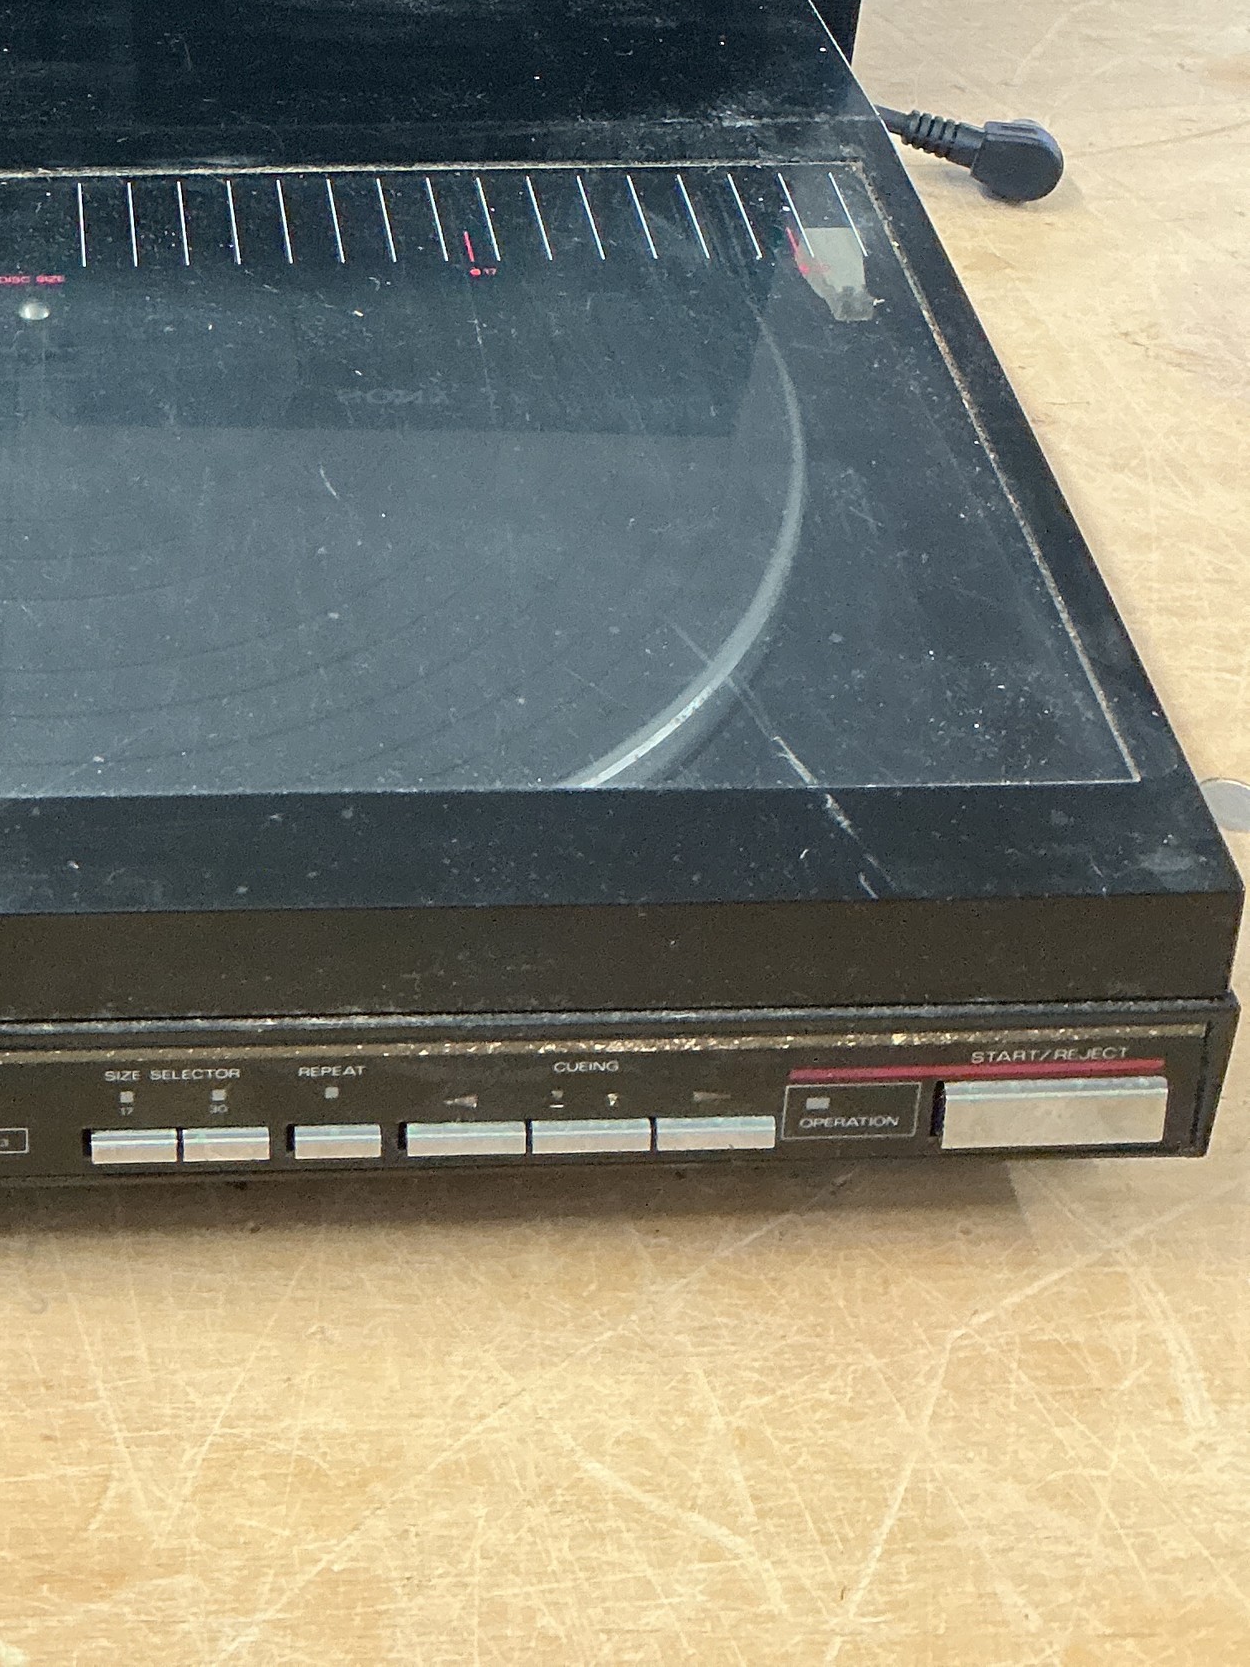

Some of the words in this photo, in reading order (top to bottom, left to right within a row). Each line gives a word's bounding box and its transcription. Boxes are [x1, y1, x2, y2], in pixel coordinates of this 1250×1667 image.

[971, 1047, 1129, 1064] START/REJECT
[298, 1066, 366, 1078] REPEAT
[553, 1060, 619, 1073] CUEING
[104, 1070, 141, 1082] SIZE
[150, 1068, 241, 1080] SELECTOR
[800, 1116, 900, 1130] OPERATION
